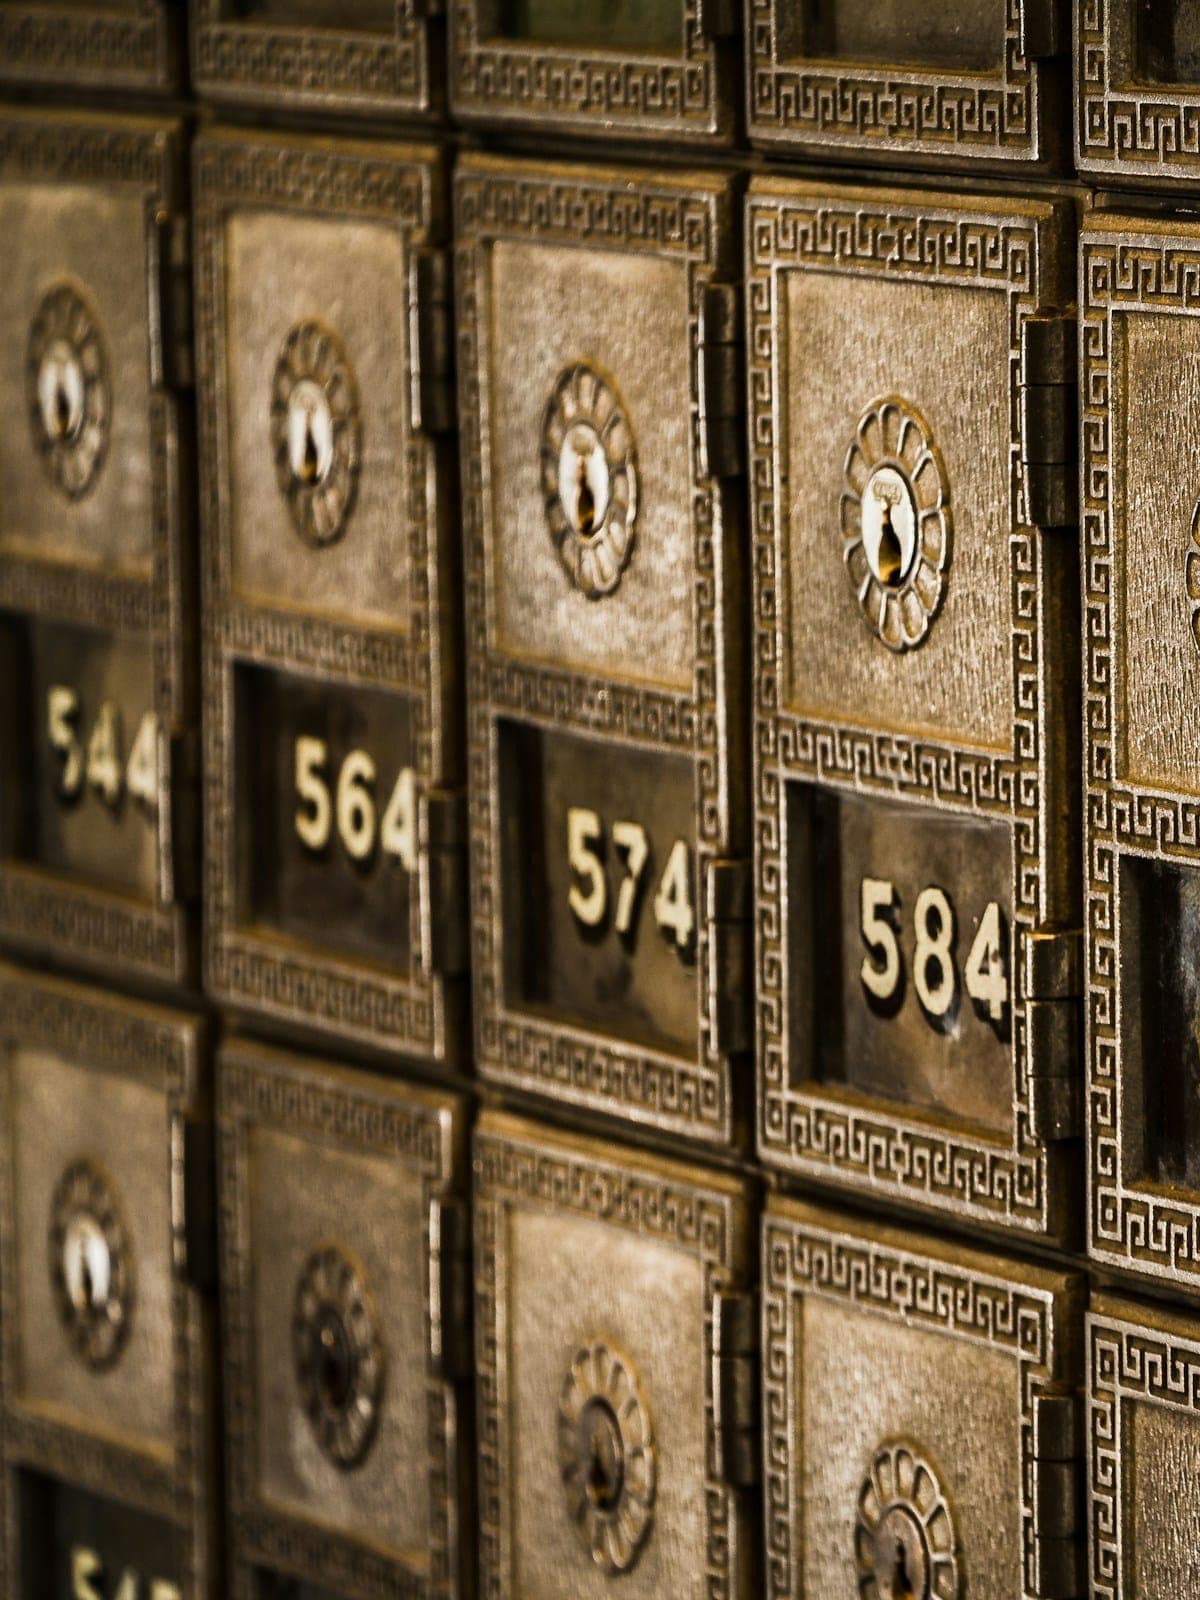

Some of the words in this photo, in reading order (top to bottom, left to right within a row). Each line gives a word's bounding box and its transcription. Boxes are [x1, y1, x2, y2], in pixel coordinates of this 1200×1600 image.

[47, 685, 159, 803] 544
[294, 735, 419, 874] 564
[567, 808, 694, 947] 574
[860, 877, 1007, 1019] 584
